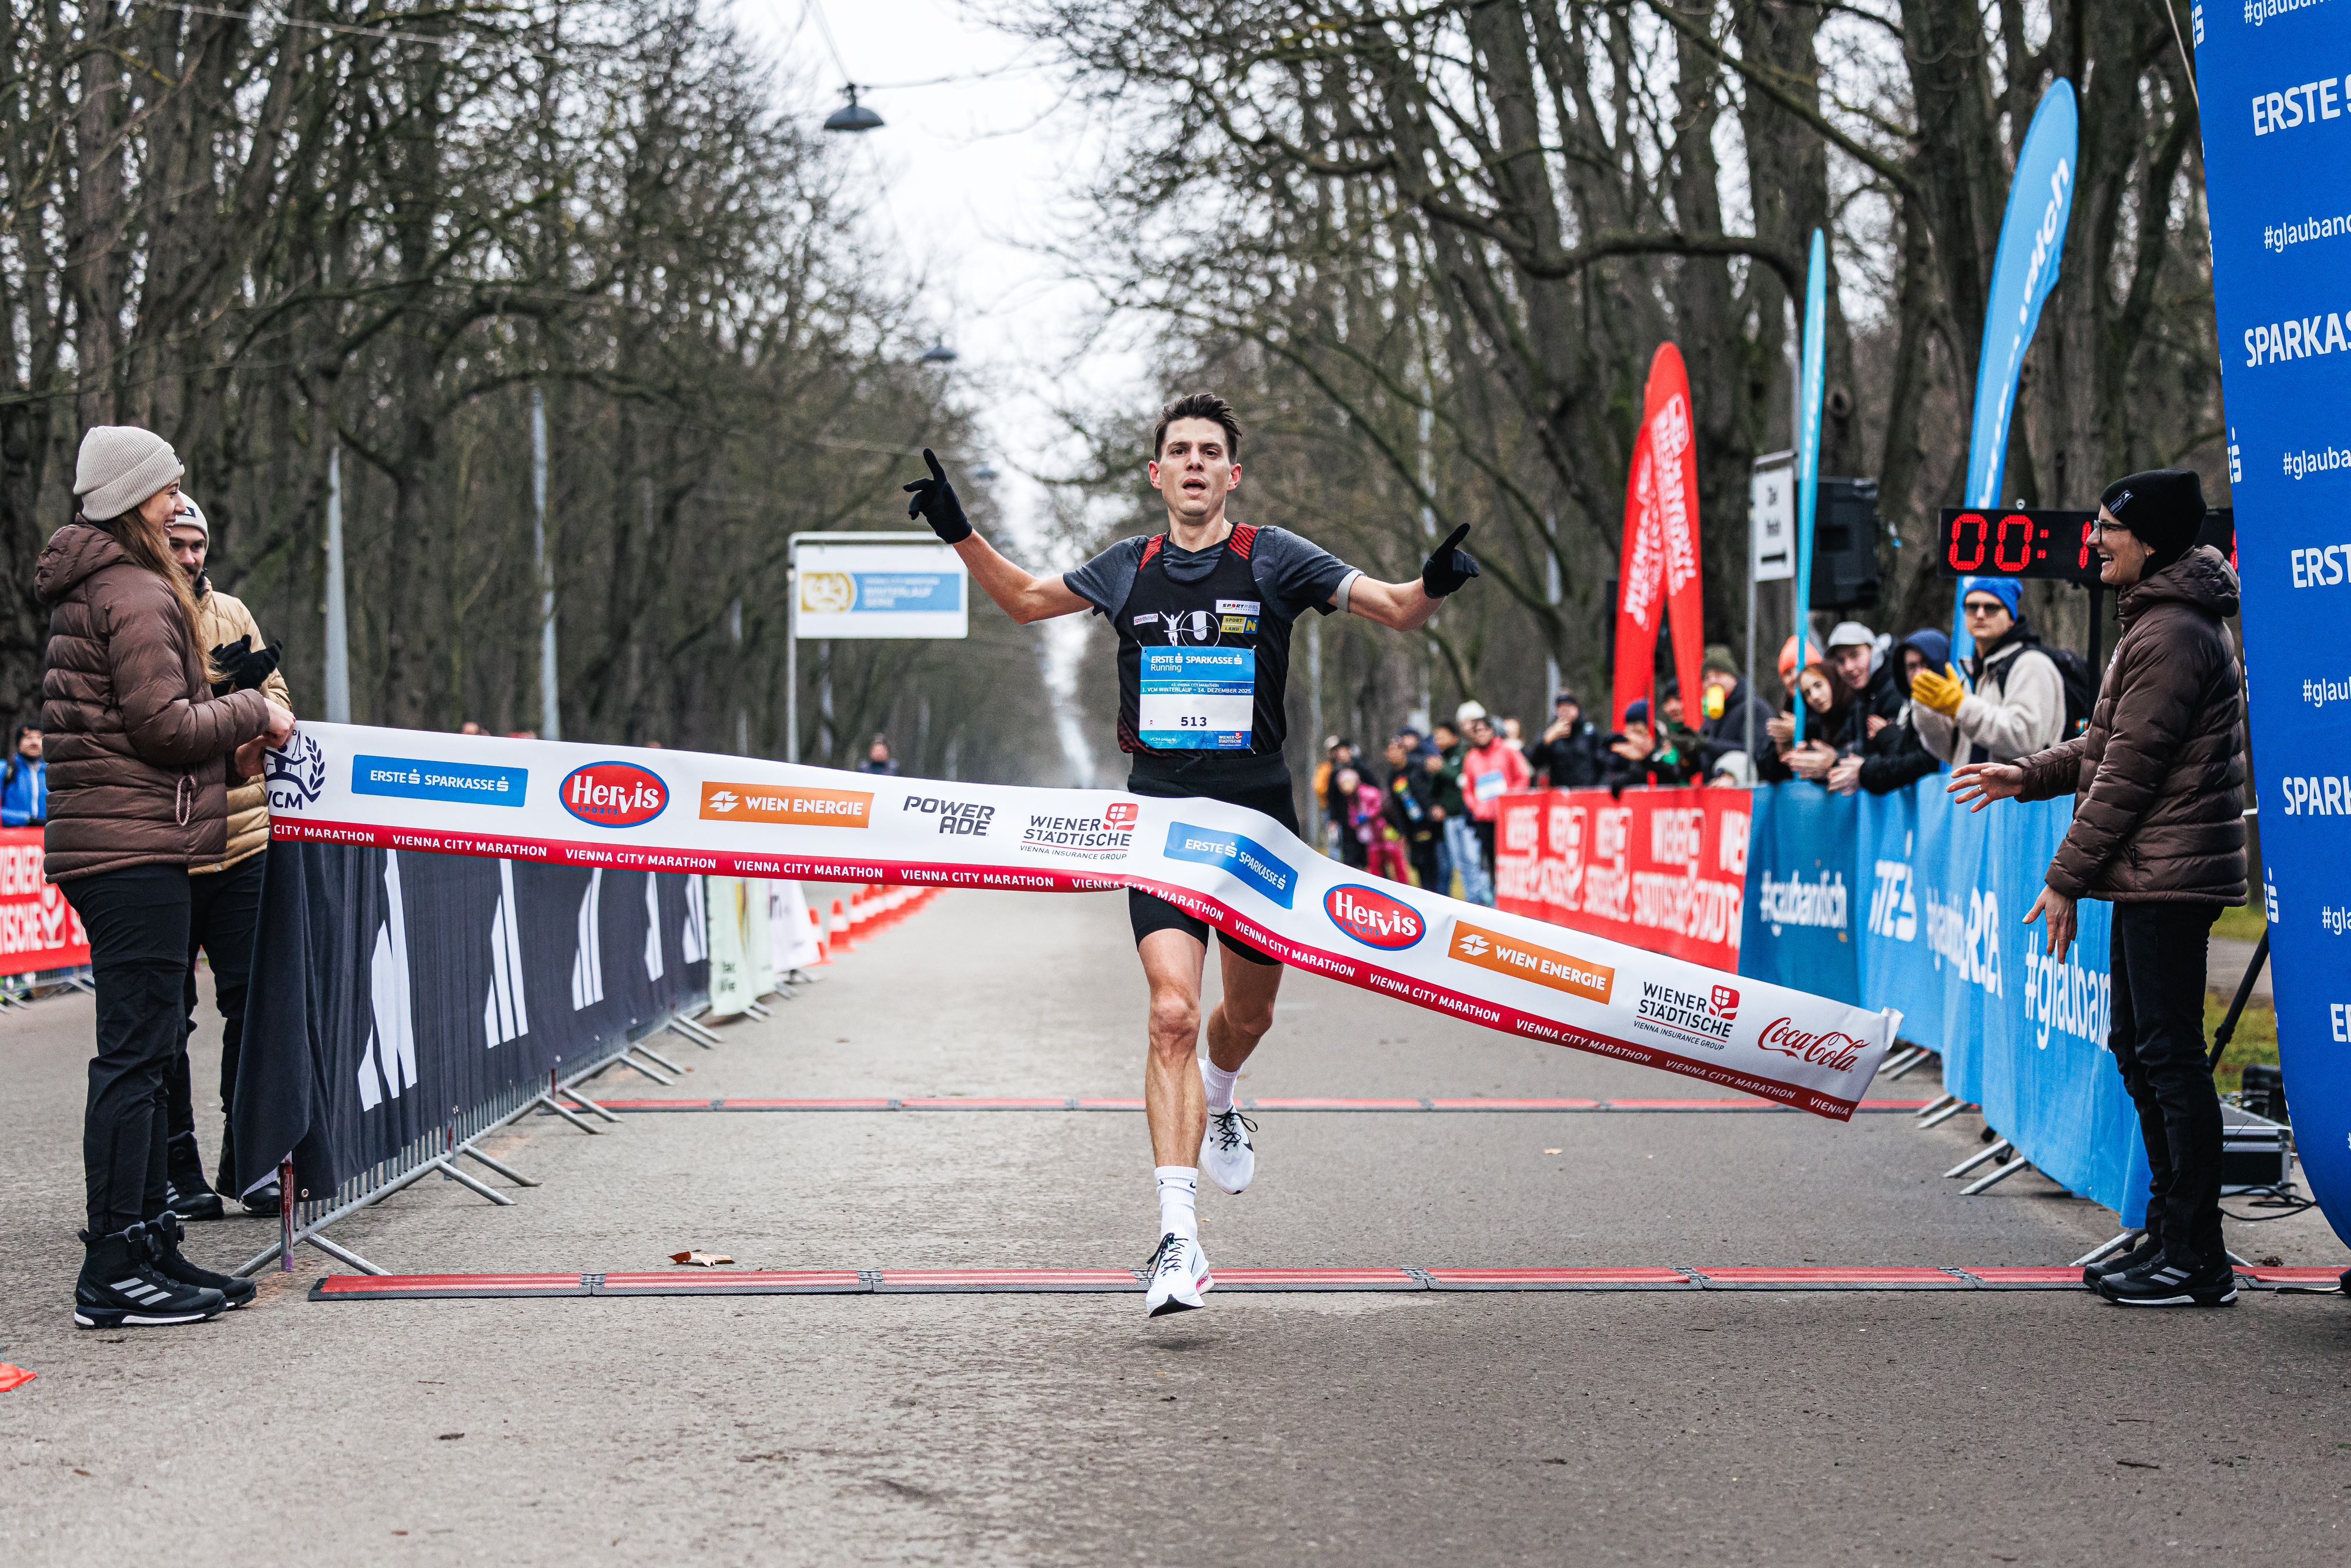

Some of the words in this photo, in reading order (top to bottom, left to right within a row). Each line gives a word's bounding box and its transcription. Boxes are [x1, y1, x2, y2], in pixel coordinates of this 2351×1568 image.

[2252, 78, 2340, 136] ERSTE
[1150, 664, 1182, 673] Running
[1185, 656, 1233, 665] SPARKASSE
[2303, 676, 2351, 708] #glau
[1181, 716, 1207, 727] 513
[370, 769, 407, 783] ERSTE
[424, 774, 495, 791] SPARKASSE
[571, 775, 659, 814] Hervis
[578, 806, 618, 815] SPORTS
[745, 796, 789, 812] WIEN
[793, 798, 864, 816] ENERGIE
[903, 796, 995, 820] POWER
[274, 825, 300, 835] CITY
[304, 828, 374, 842] MARATHON
[939, 816, 990, 836] ADE
[1031, 815, 1101, 832] WIENER
[393, 835, 440, 847] VIENNA
[444, 839, 473, 850] CITY
[476, 842, 547, 856] MARATHON
[1023, 829, 1133, 846] STÄDTISCHE
[565, 849, 613, 862] VIENNA
[617, 853, 645, 864] CITY
[648, 855, 716, 869] MARATHON
[1020, 845, 1049, 854] VIENNA
[1051, 850, 1099, 860] INSURANCE
[1184, 838, 1224, 854] ERSTE
[1238, 851, 1280, 886] SPARKASSE
[734, 860, 780, 872] VIENNA
[783, 863, 811, 874] CITY
[814, 865, 883, 877] MARATHON
[900, 870, 949, 881] VIENNA
[952, 872, 980, 883] CITY
[983, 874, 1054, 887] MARATHON
[1071, 879, 1121, 889] VIENNA
[1157, 889, 1224, 921] MARATHON
[1335, 890, 1417, 936] Hervis
[1342, 920, 1379, 936] SPORTS
[1235, 920, 1267, 945] VIENNA
[1268, 939, 1290, 956] CITY
[1291, 949, 1355, 977] MARATHON
[1496, 944, 1538, 970] WIEN
[1539, 959, 1606, 991] ENERGIE
[1370, 973, 1409, 994] VIENNA
[1412, 987, 1438, 1002] CITY
[1438, 995, 1501, 1022] MARATHON
[1643, 981, 1707, 1013] WIENER
[1638, 999, 1733, 1038] STÄDTISCHE
[1517, 1019, 1559, 1039] VIENNA
[1561, 1033, 1588, 1046] CITY
[1588, 1040, 1652, 1062] MARATHON
[1634, 1020, 1659, 1034] VIENNA
[1660, 1028, 1700, 1045] INSURANCE
[1700, 1040, 1724, 1051] GROUP
[1758, 1017, 1870, 1073] Coca-Cola
[1666, 1060, 1706, 1077] VIENNA
[1708, 1071, 1735, 1083] CITY
[1734, 1078, 1796, 1099] MARATHON
[1810, 1097, 1850, 1115] VIENNA
